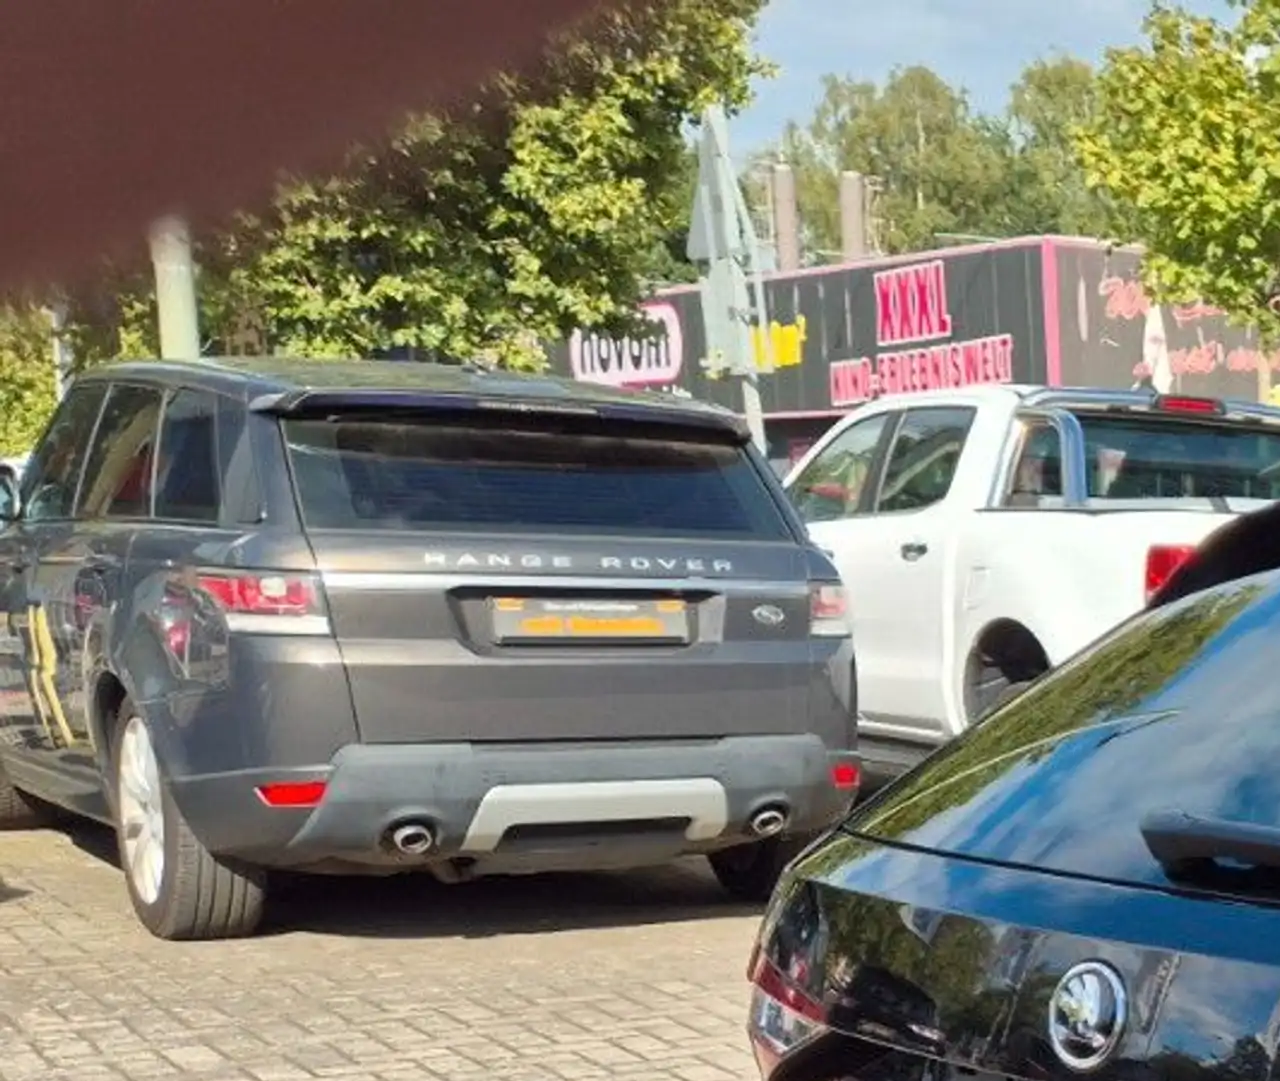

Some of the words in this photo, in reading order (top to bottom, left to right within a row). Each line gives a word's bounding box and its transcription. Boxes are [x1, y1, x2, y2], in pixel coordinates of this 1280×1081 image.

[873, 259, 952, 346] XXXL
[830, 334, 1013, 407] KINO-ERLEBNISWELT
[423, 552, 573, 569] RANGE
[600, 555, 733, 572] ROVER
